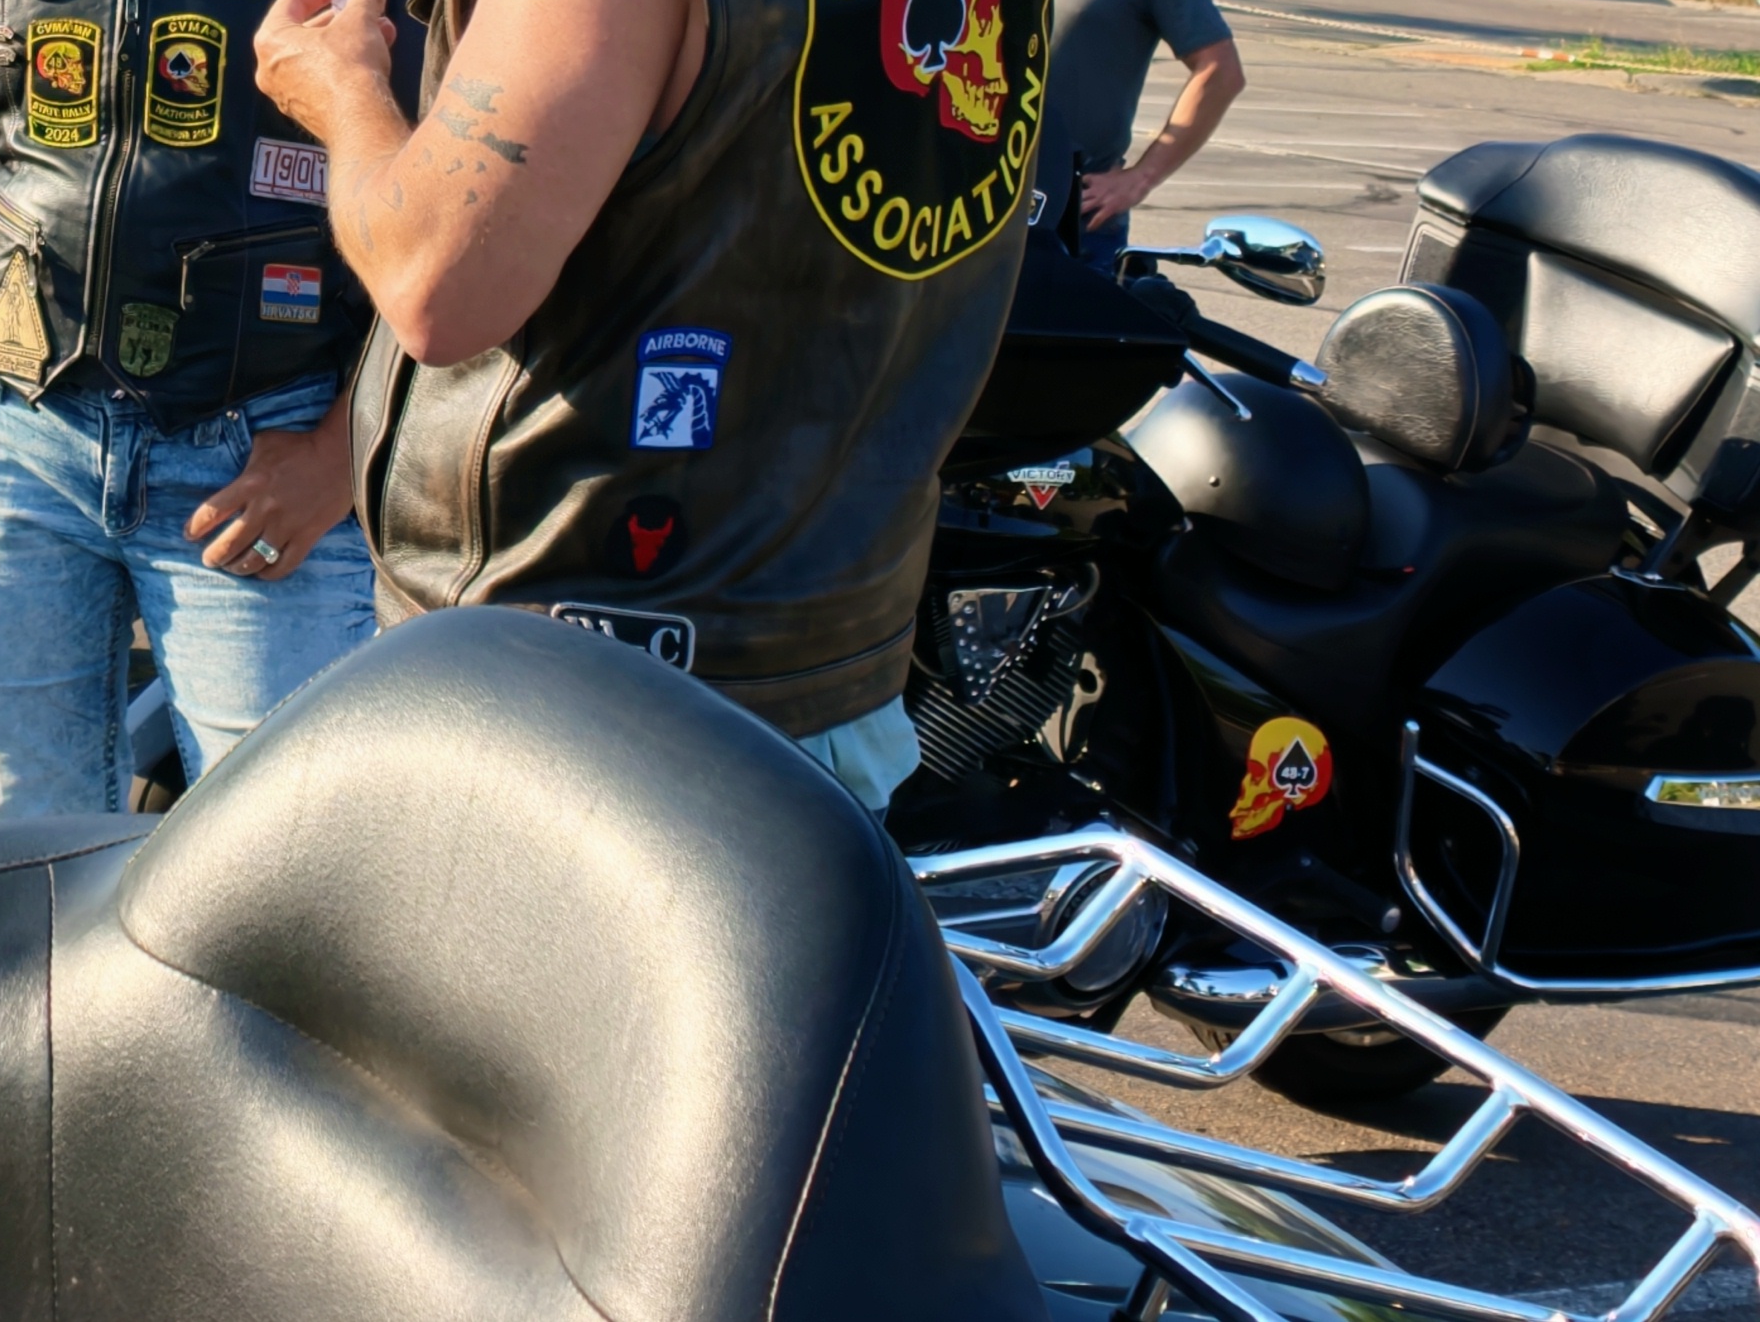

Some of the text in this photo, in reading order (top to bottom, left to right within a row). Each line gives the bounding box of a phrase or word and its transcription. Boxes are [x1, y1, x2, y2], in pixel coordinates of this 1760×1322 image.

[32, 101, 91, 118] STATE RALLY
[155, 104, 209, 120] NATIONAL
[45, 128, 79, 142] 2024
[644, 332, 727, 356] AIRBORNE
[1012, 469, 1074, 481] VICTORY
